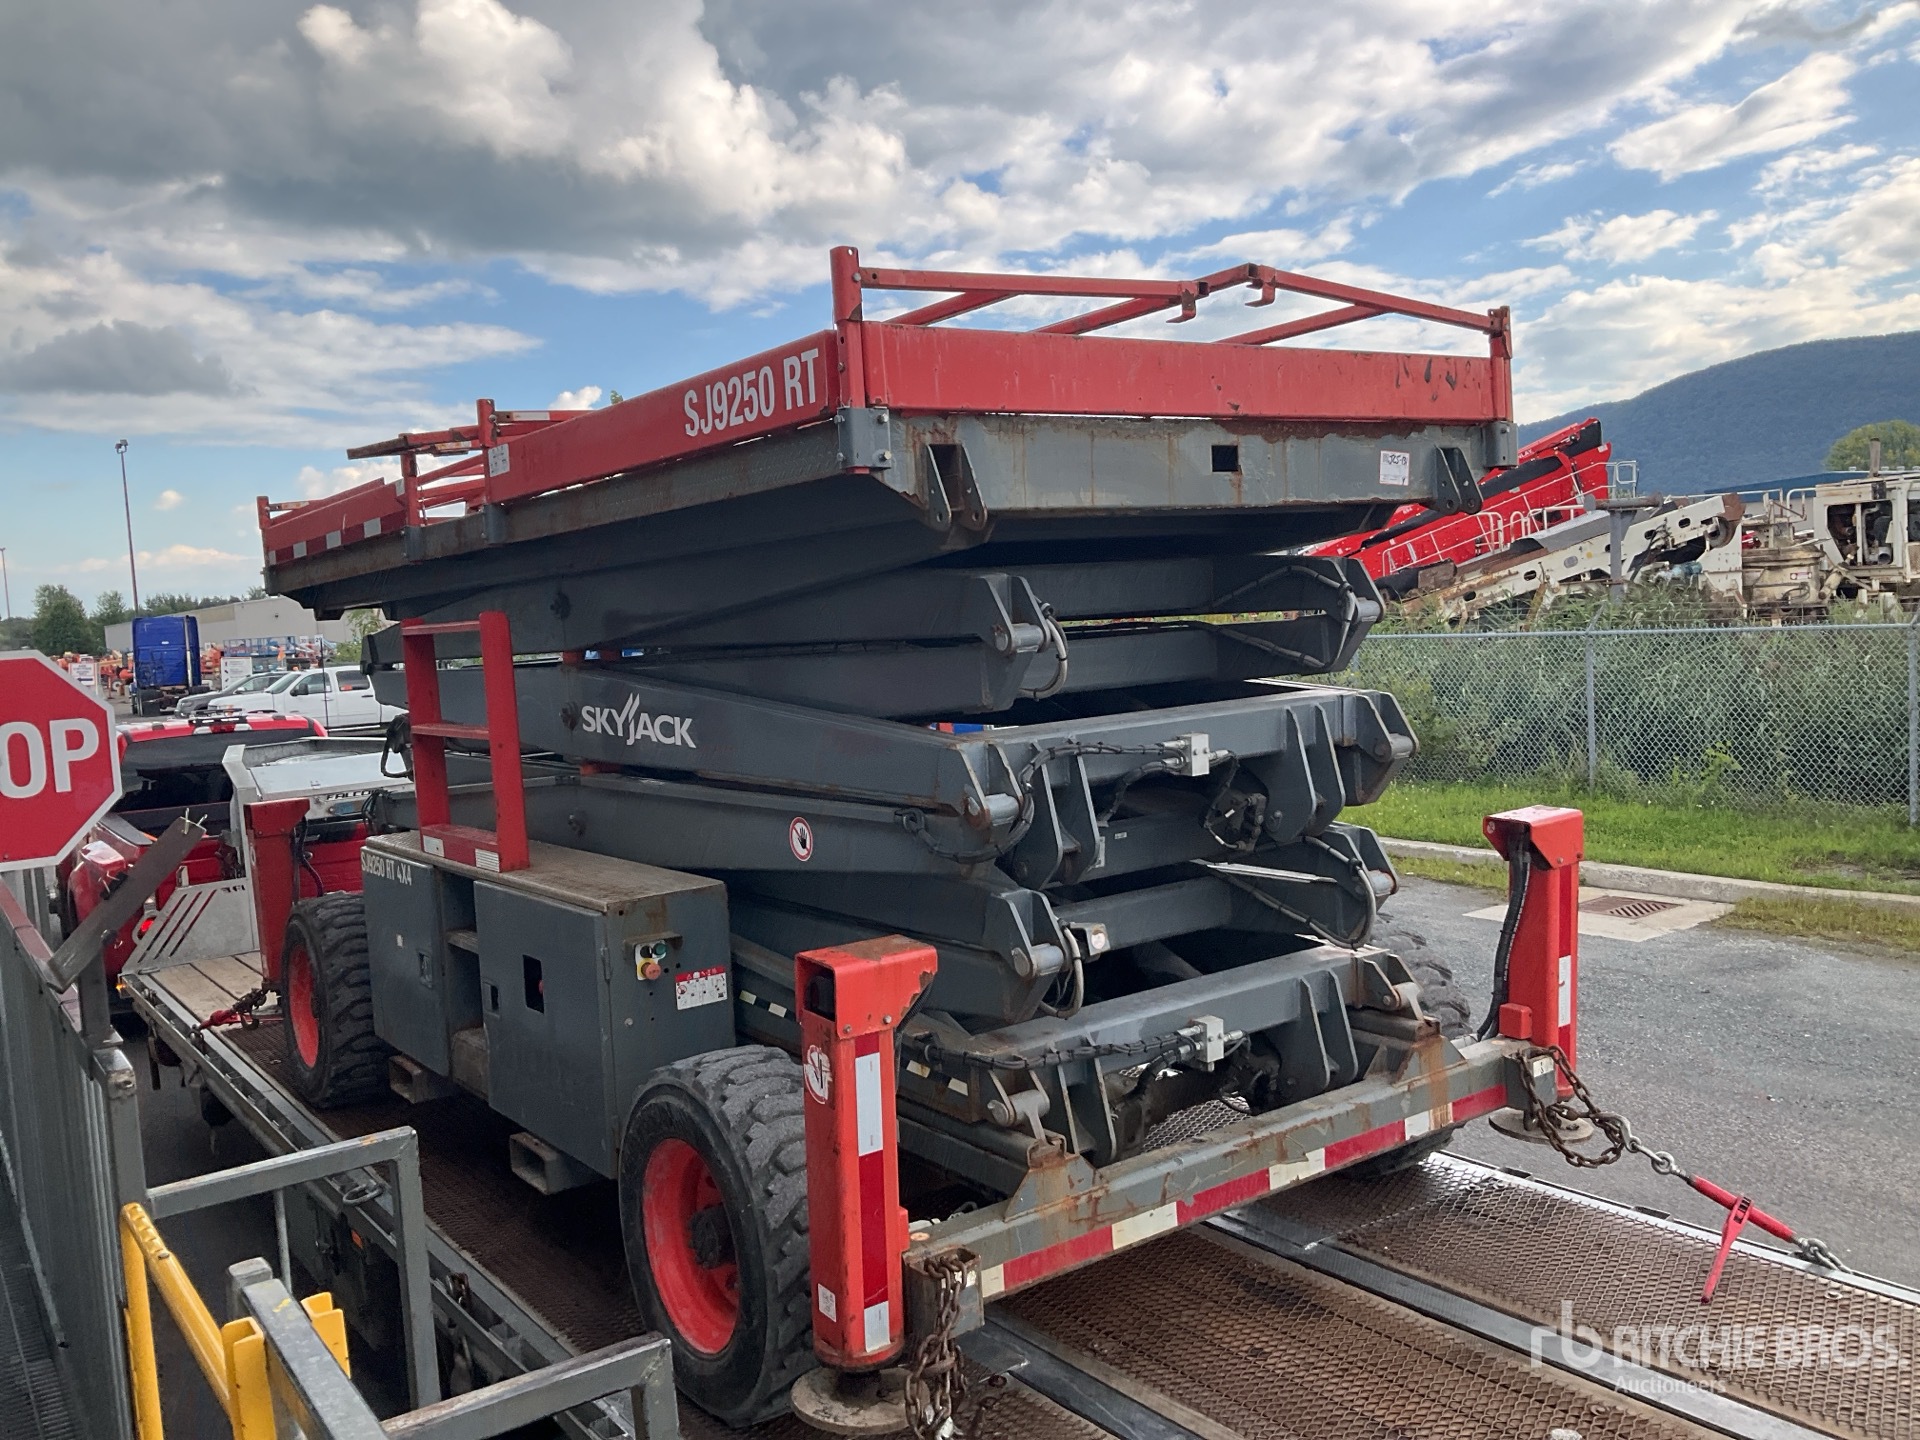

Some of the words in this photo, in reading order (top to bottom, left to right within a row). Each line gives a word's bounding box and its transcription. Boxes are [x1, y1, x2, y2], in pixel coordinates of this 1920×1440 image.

[684, 366, 775, 437] SJ9250
[783, 348, 819, 411] RT
[581, 692, 697, 749] SKYJACK
[361, 851, 386, 878] SJ9250
[386, 858, 395, 881] RT
[396, 863, 412, 886] 4X4
